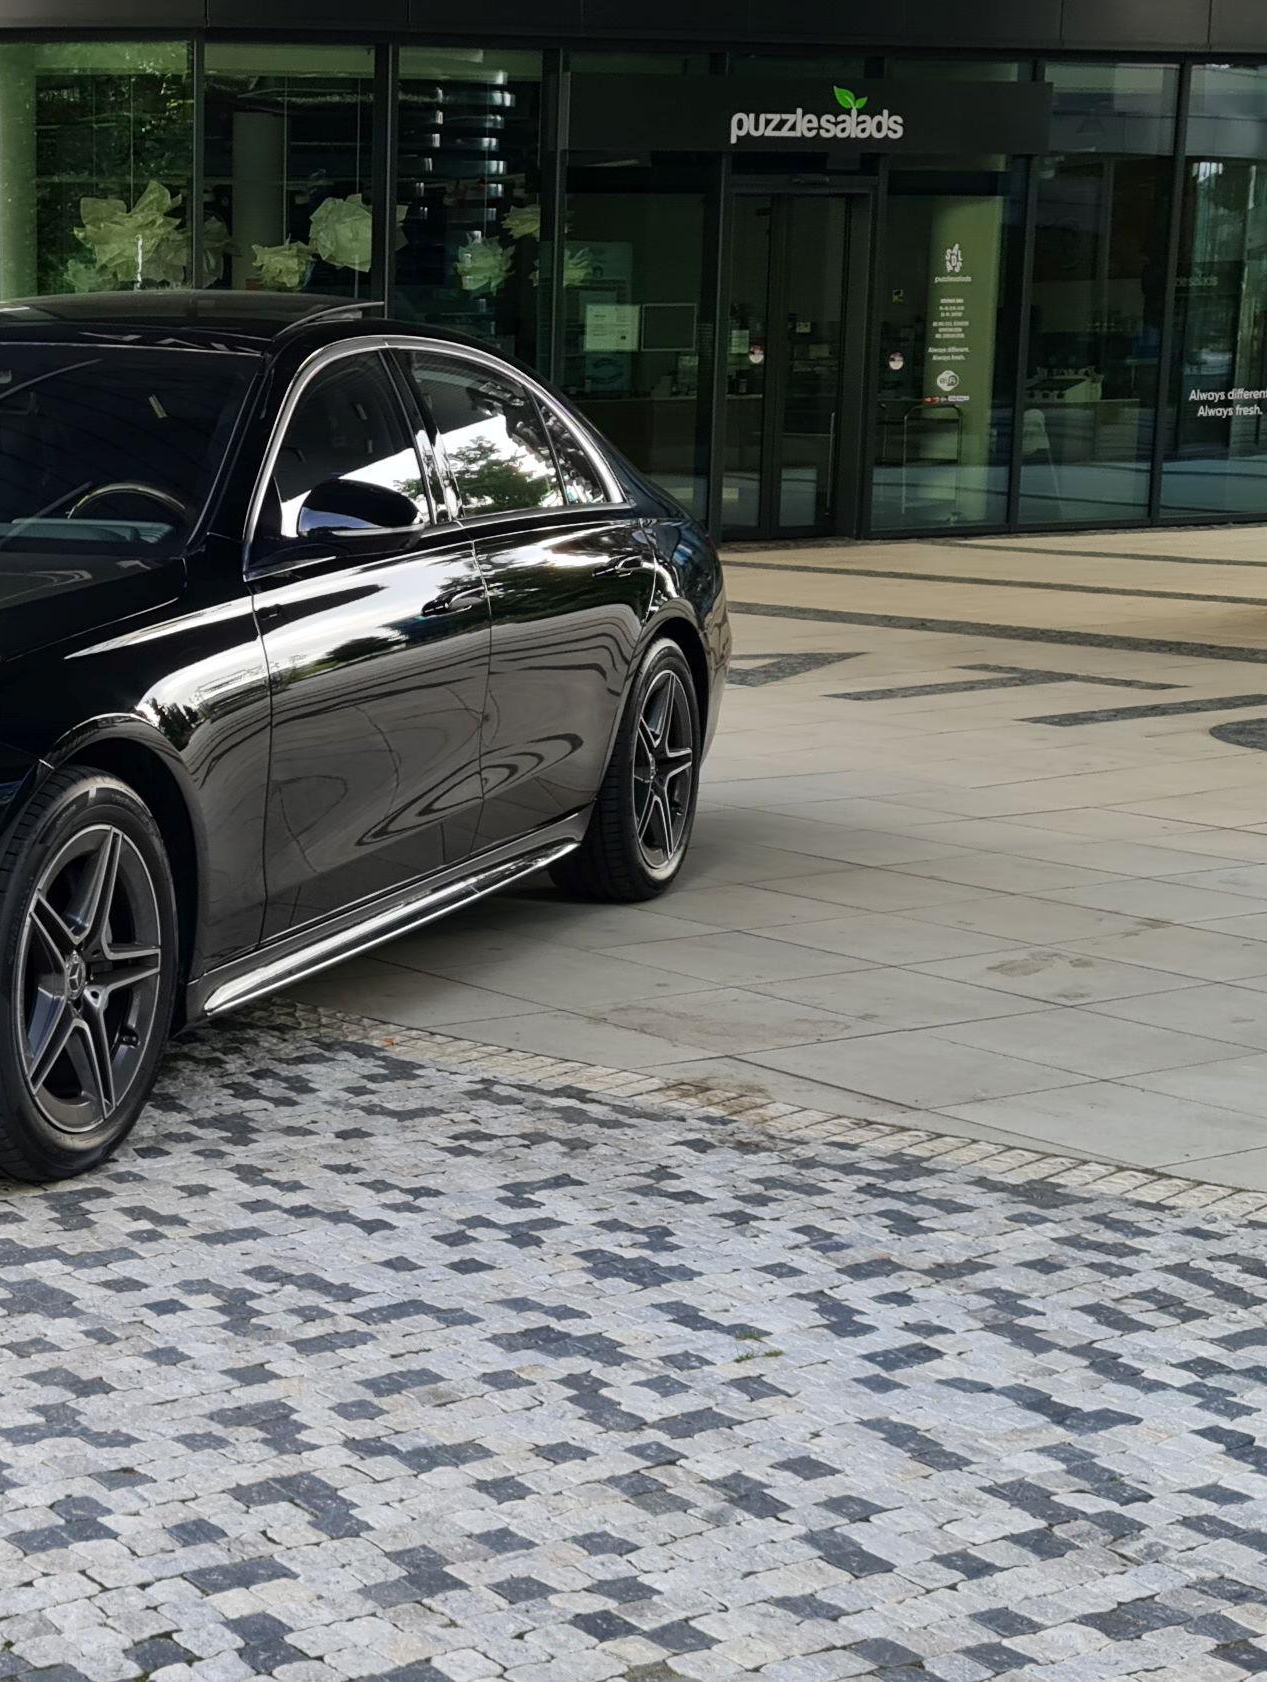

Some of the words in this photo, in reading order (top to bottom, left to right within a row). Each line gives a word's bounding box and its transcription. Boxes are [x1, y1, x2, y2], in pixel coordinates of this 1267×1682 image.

[730, 107, 904, 144] puzzlesalads
[1188, 388, 1225, 402] Always
[1197, 405, 1234, 419] Always
[1235, 404, 1264, 416] fresh.
